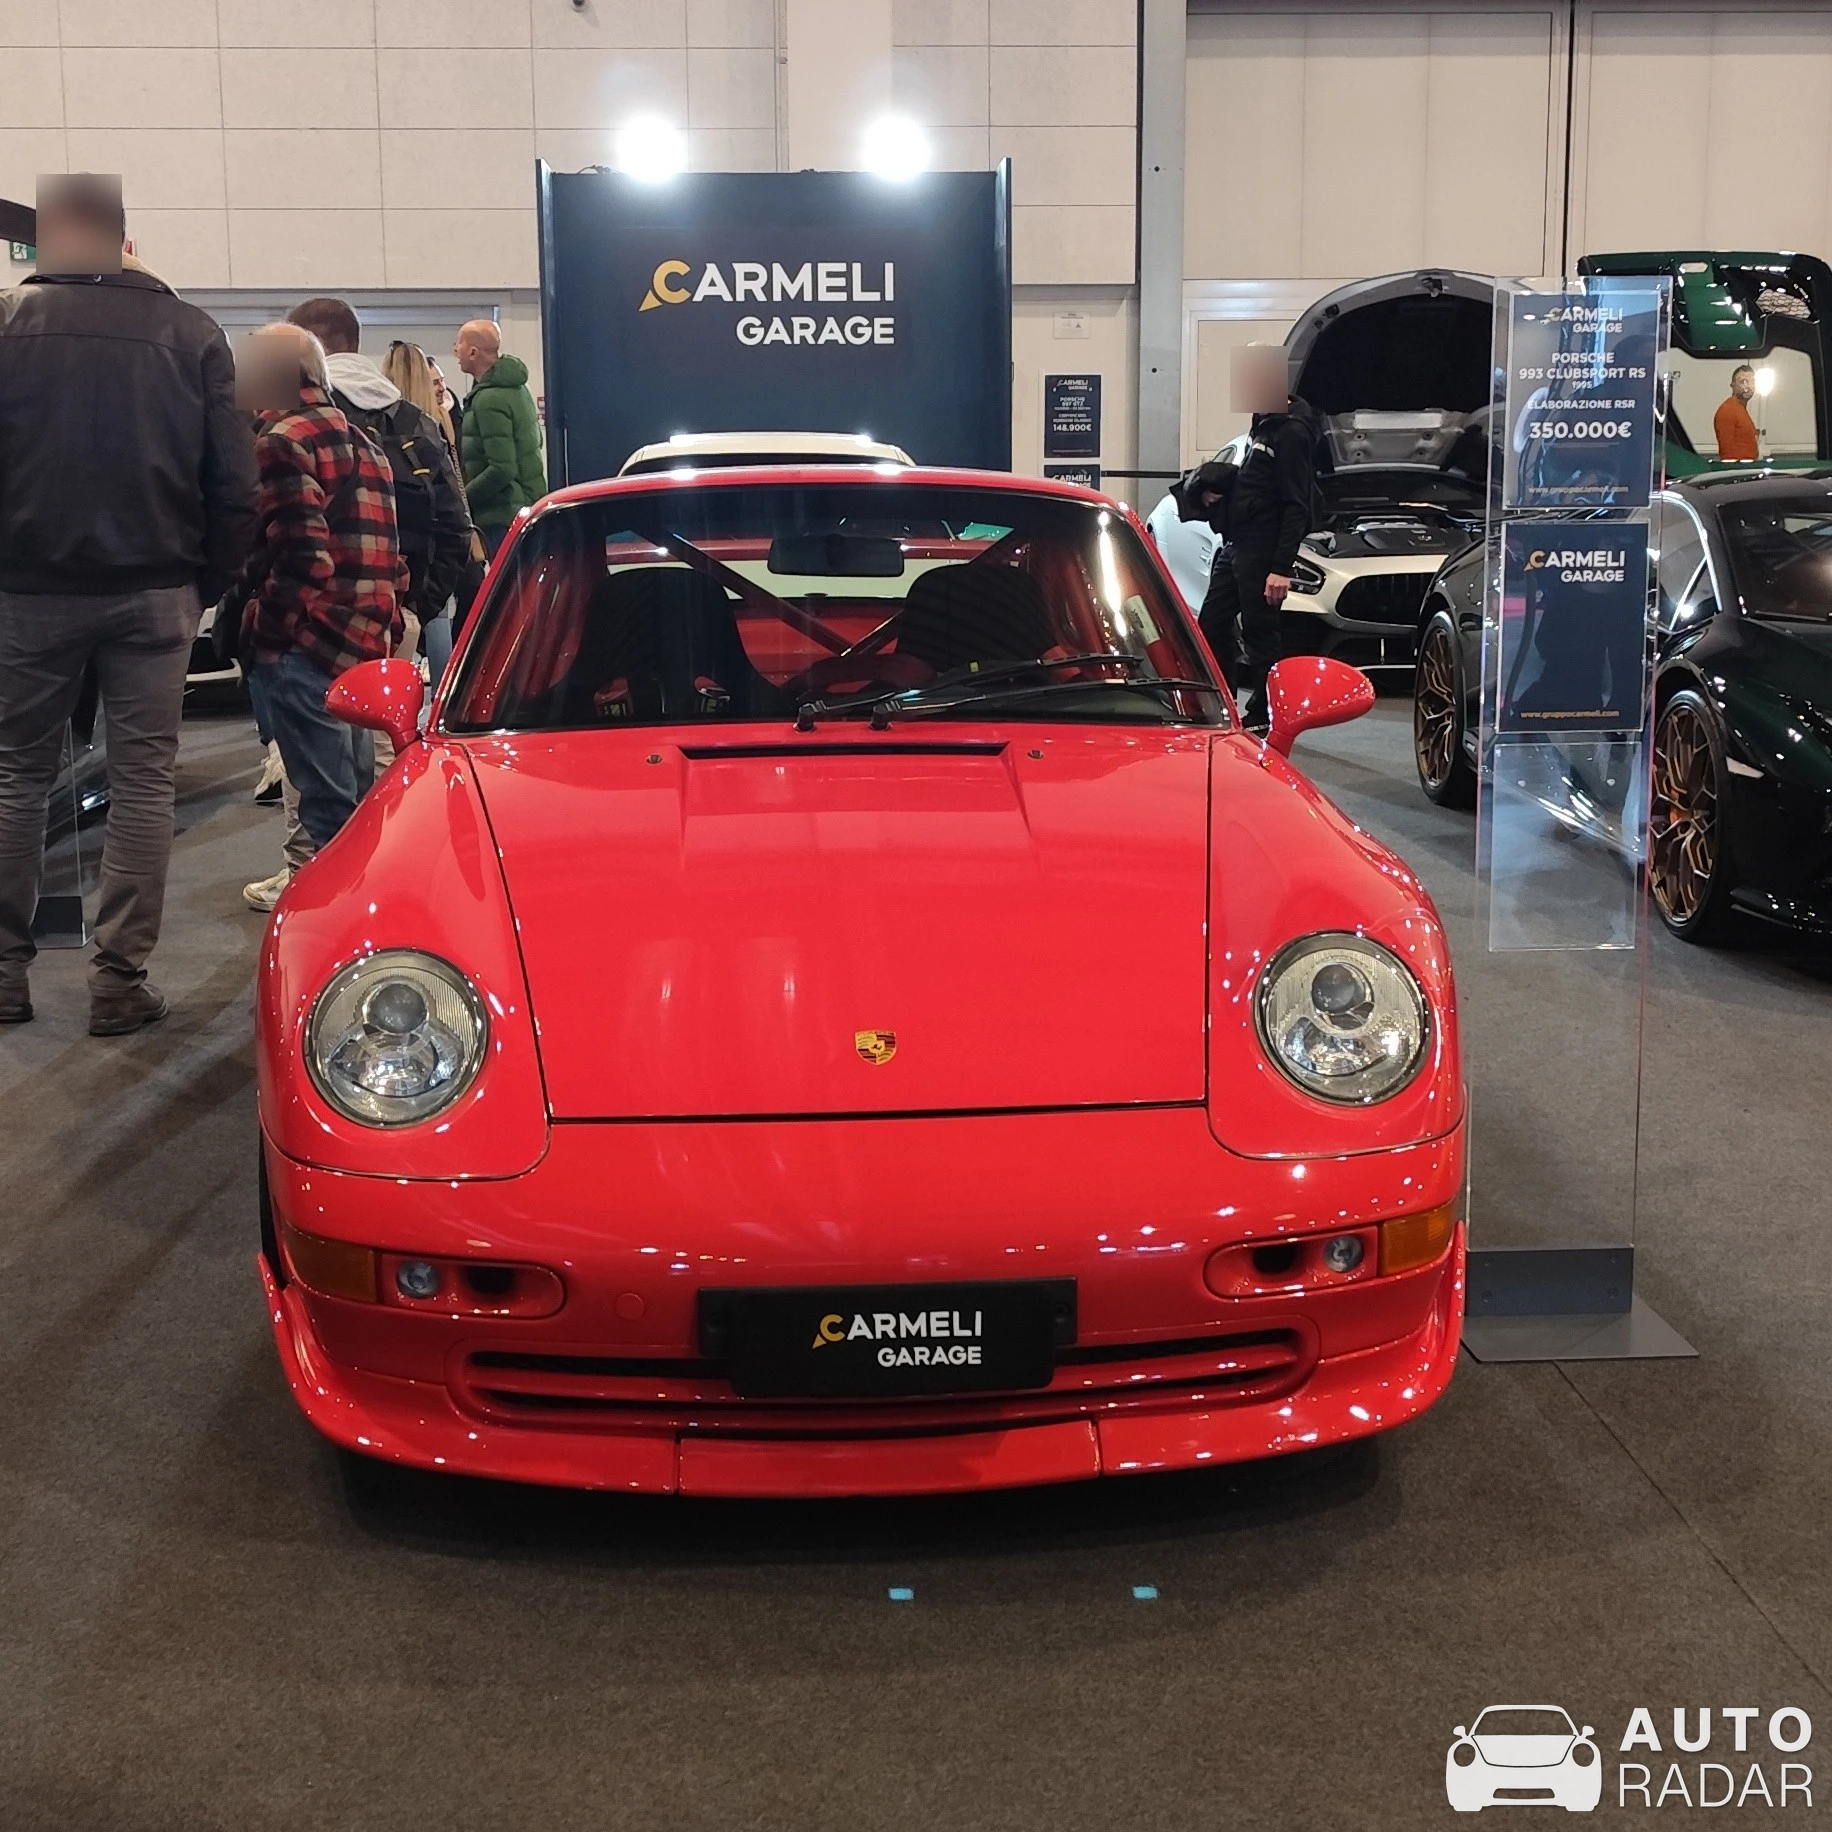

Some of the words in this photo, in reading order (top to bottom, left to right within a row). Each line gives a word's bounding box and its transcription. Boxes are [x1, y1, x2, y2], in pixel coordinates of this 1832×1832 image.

[639, 260, 895, 311] CARMELI
[1540, 306, 1623, 325] CARMELI
[736, 316, 895, 346] GARAGE
[1573, 323, 1623, 334] GARAGE
[1551, 352, 1615, 364] PORSCHE
[1519, 368, 1544, 379] 993
[1547, 367, 1626, 379] CLUBSPORT
[1628, 367, 1647, 379] RS
[1527, 400, 1612, 410] ELABORAZIONE
[1614, 400, 1636, 409] RSR
[1053, 424, 1092, 432] 148.900€
[1529, 422, 1632, 439] 350.000€
[1524, 550, 1625, 571] CARMELI
[1560, 570, 1625, 583] GARAGE
[812, 1311, 982, 1350] CARMELI
[877, 1346, 982, 1368] GARAGE
